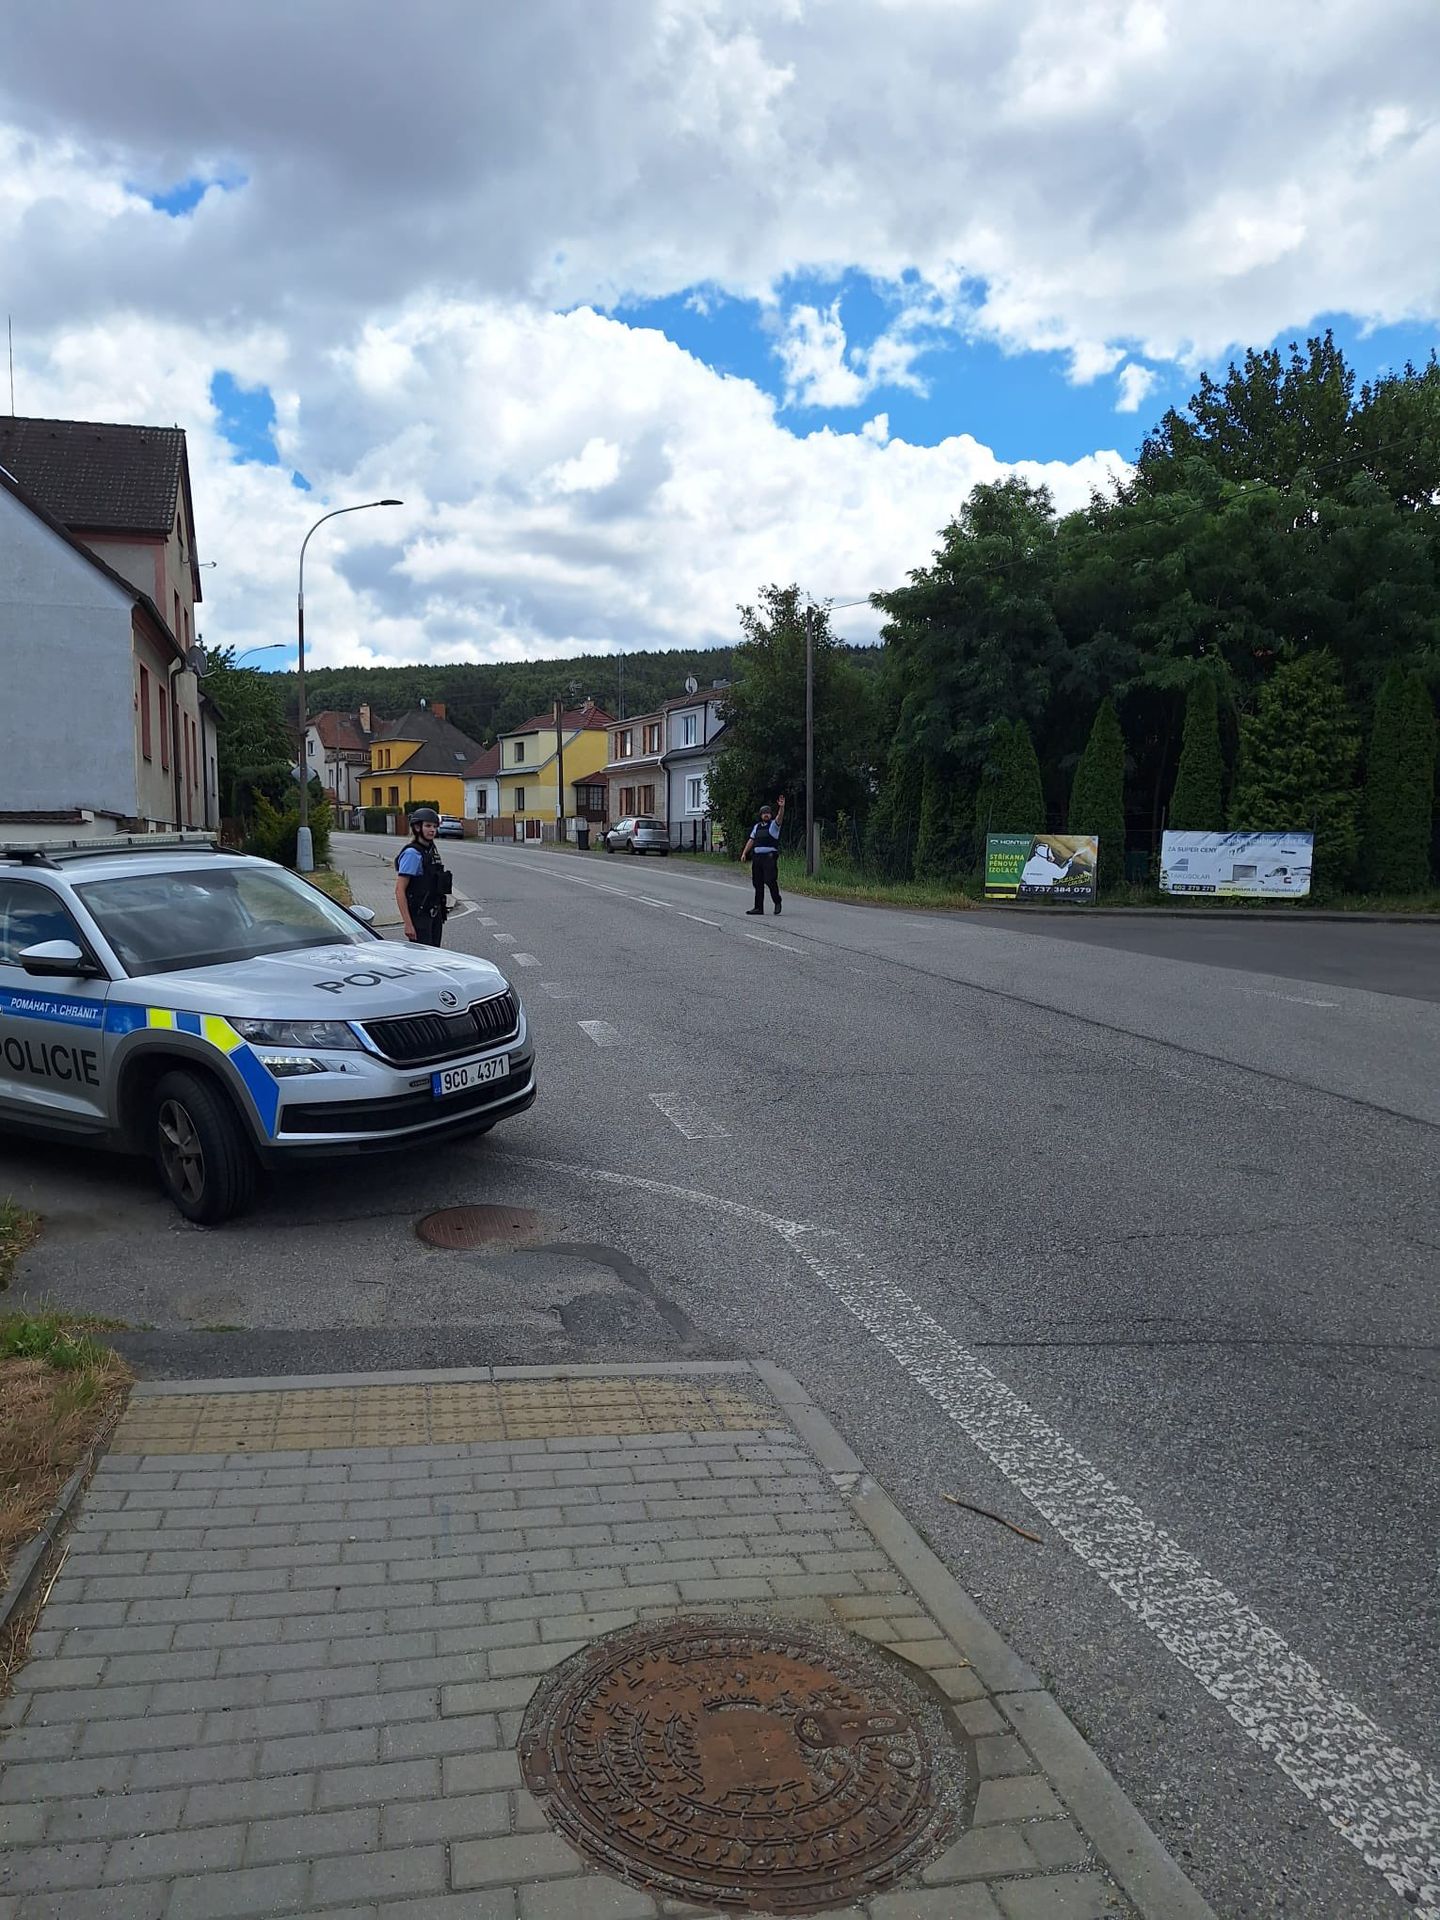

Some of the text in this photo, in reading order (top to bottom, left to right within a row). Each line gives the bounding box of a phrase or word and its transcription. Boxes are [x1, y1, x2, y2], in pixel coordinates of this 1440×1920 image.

[312, 961, 468, 994] POLICIE
[10, 997, 50, 1013] POMÁHAT
[59, 1004, 99, 1019] CHRÁNIT
[0, 1037, 100, 1087] OLICIE
[477, 1057, 505, 1081] 4371
